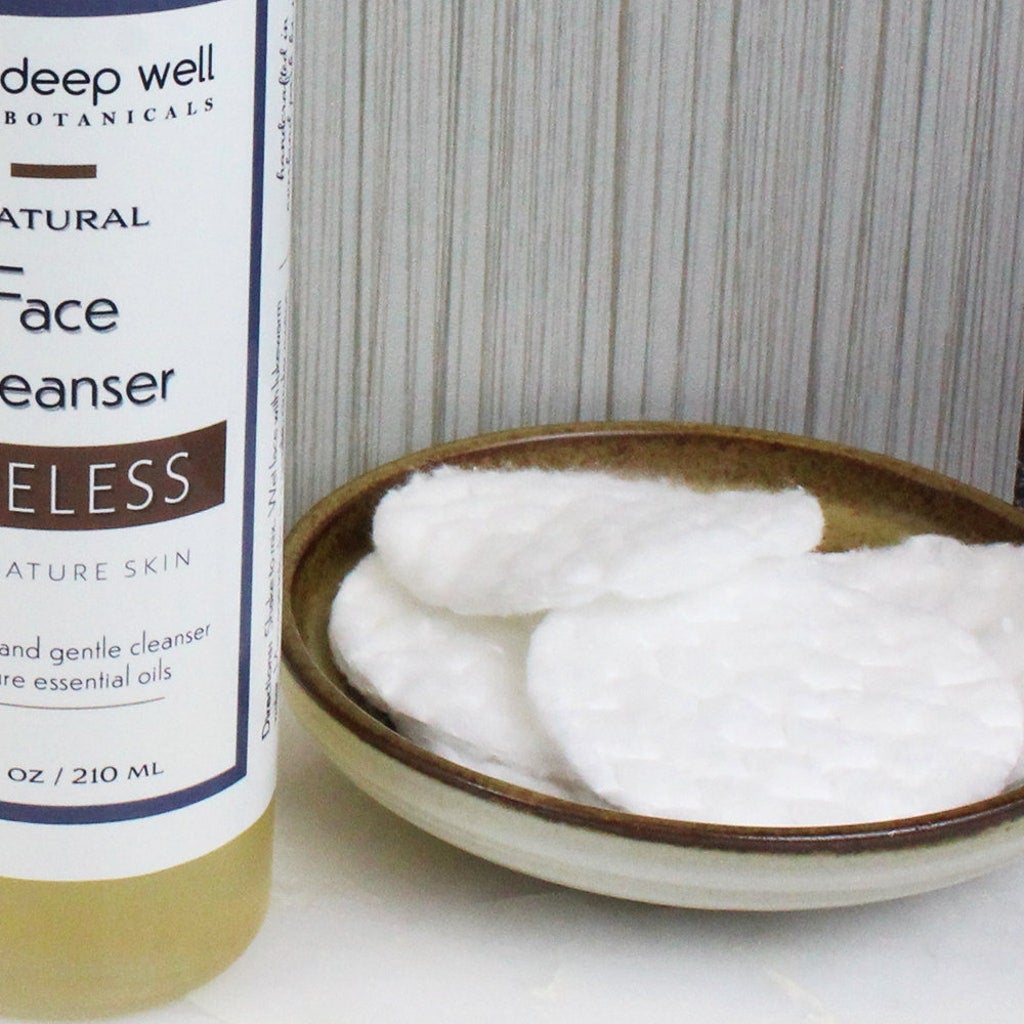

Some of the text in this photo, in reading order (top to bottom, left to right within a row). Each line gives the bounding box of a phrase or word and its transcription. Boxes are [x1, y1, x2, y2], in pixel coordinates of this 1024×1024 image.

[0, 43, 214, 106] deep well
[5, 97, 214, 127] BOTANICALS
[125, 550, 190, 577] SKIN
[50, 639, 121, 666] gentle
[130, 625, 209, 655] cleanser
[34, 661, 129, 691] essential
[138, 662, 171, 684] oils
[8, 768, 44, 783] OZ
[54, 768, 63, 785] /
[72, 766, 117, 784] 210
[128, 762, 164, 779] ML
